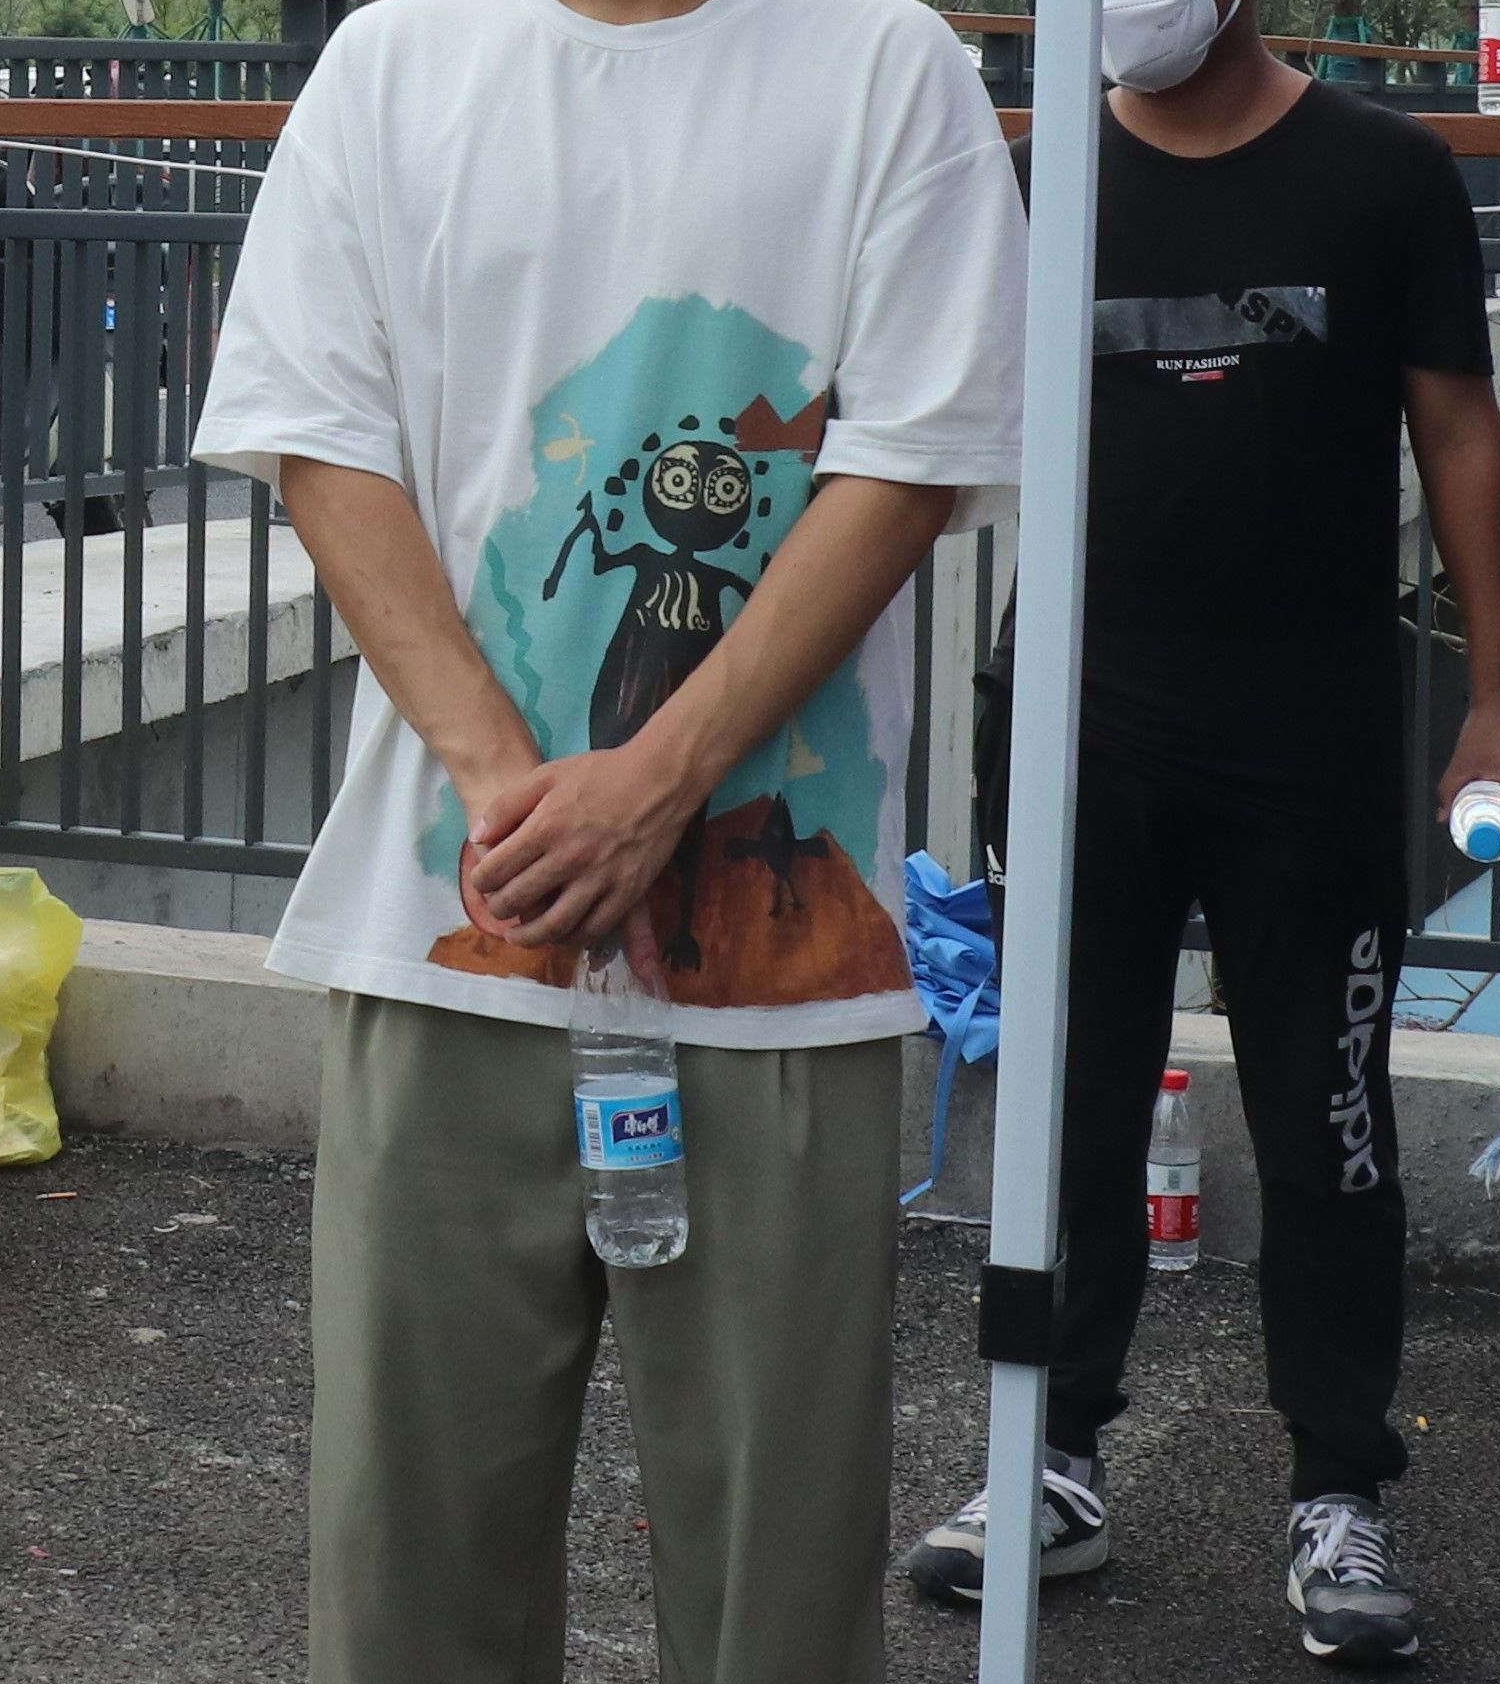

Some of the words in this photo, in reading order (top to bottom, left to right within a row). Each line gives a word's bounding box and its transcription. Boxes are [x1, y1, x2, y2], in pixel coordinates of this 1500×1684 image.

[1156, 359, 1183, 371] RUN
[1185, 354, 1240, 370] FASHION
[1330, 926, 1384, 1193] adidas
